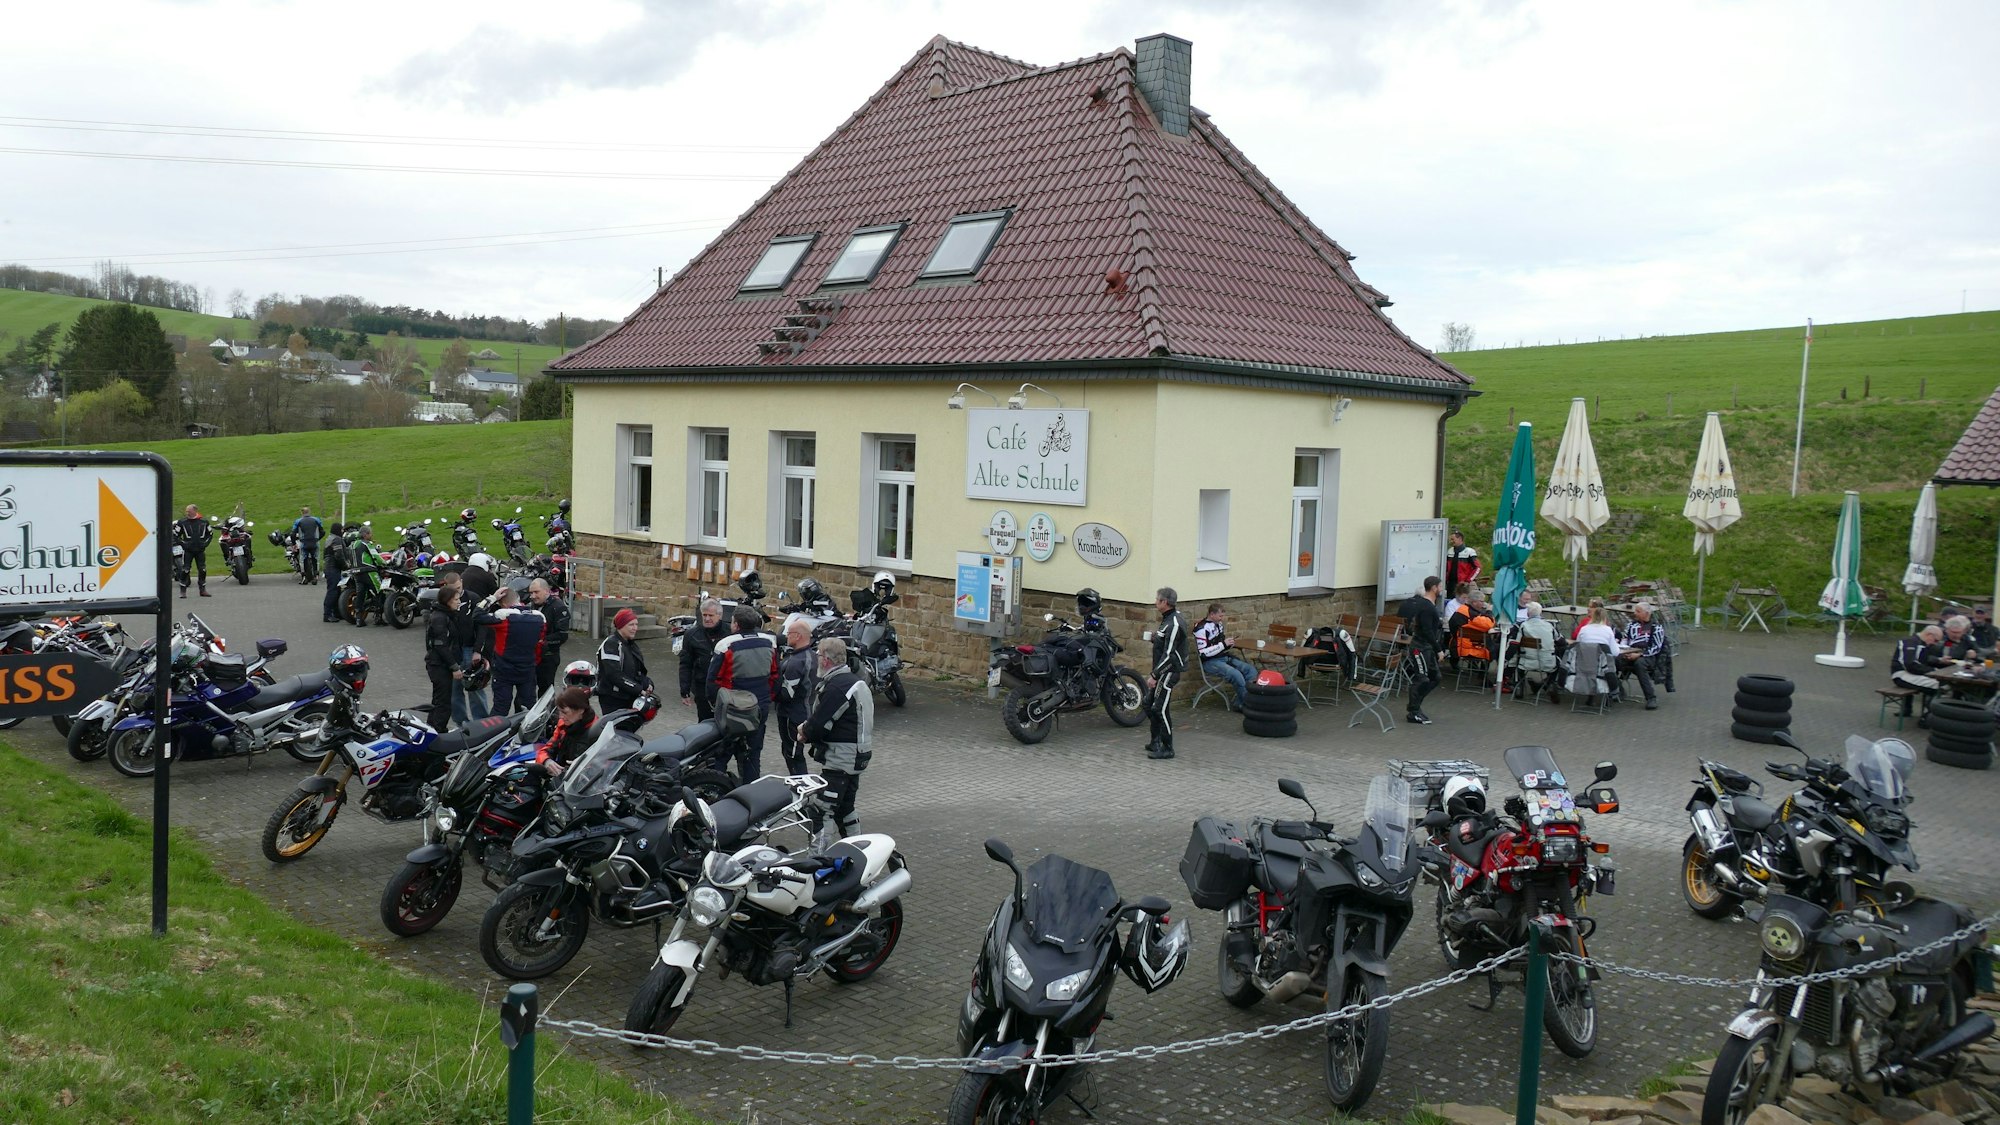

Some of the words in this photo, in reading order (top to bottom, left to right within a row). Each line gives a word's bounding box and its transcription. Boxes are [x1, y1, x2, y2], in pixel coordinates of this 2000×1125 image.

[986, 423, 1027, 450] Café
[973, 460, 1009, 487] Alte
[1016, 463, 1079, 491] Schule
[1416, 490, 1423, 499] 70
[996, 539, 1008, 547] Pils
[1077, 538, 1123, 556] Krombacher
